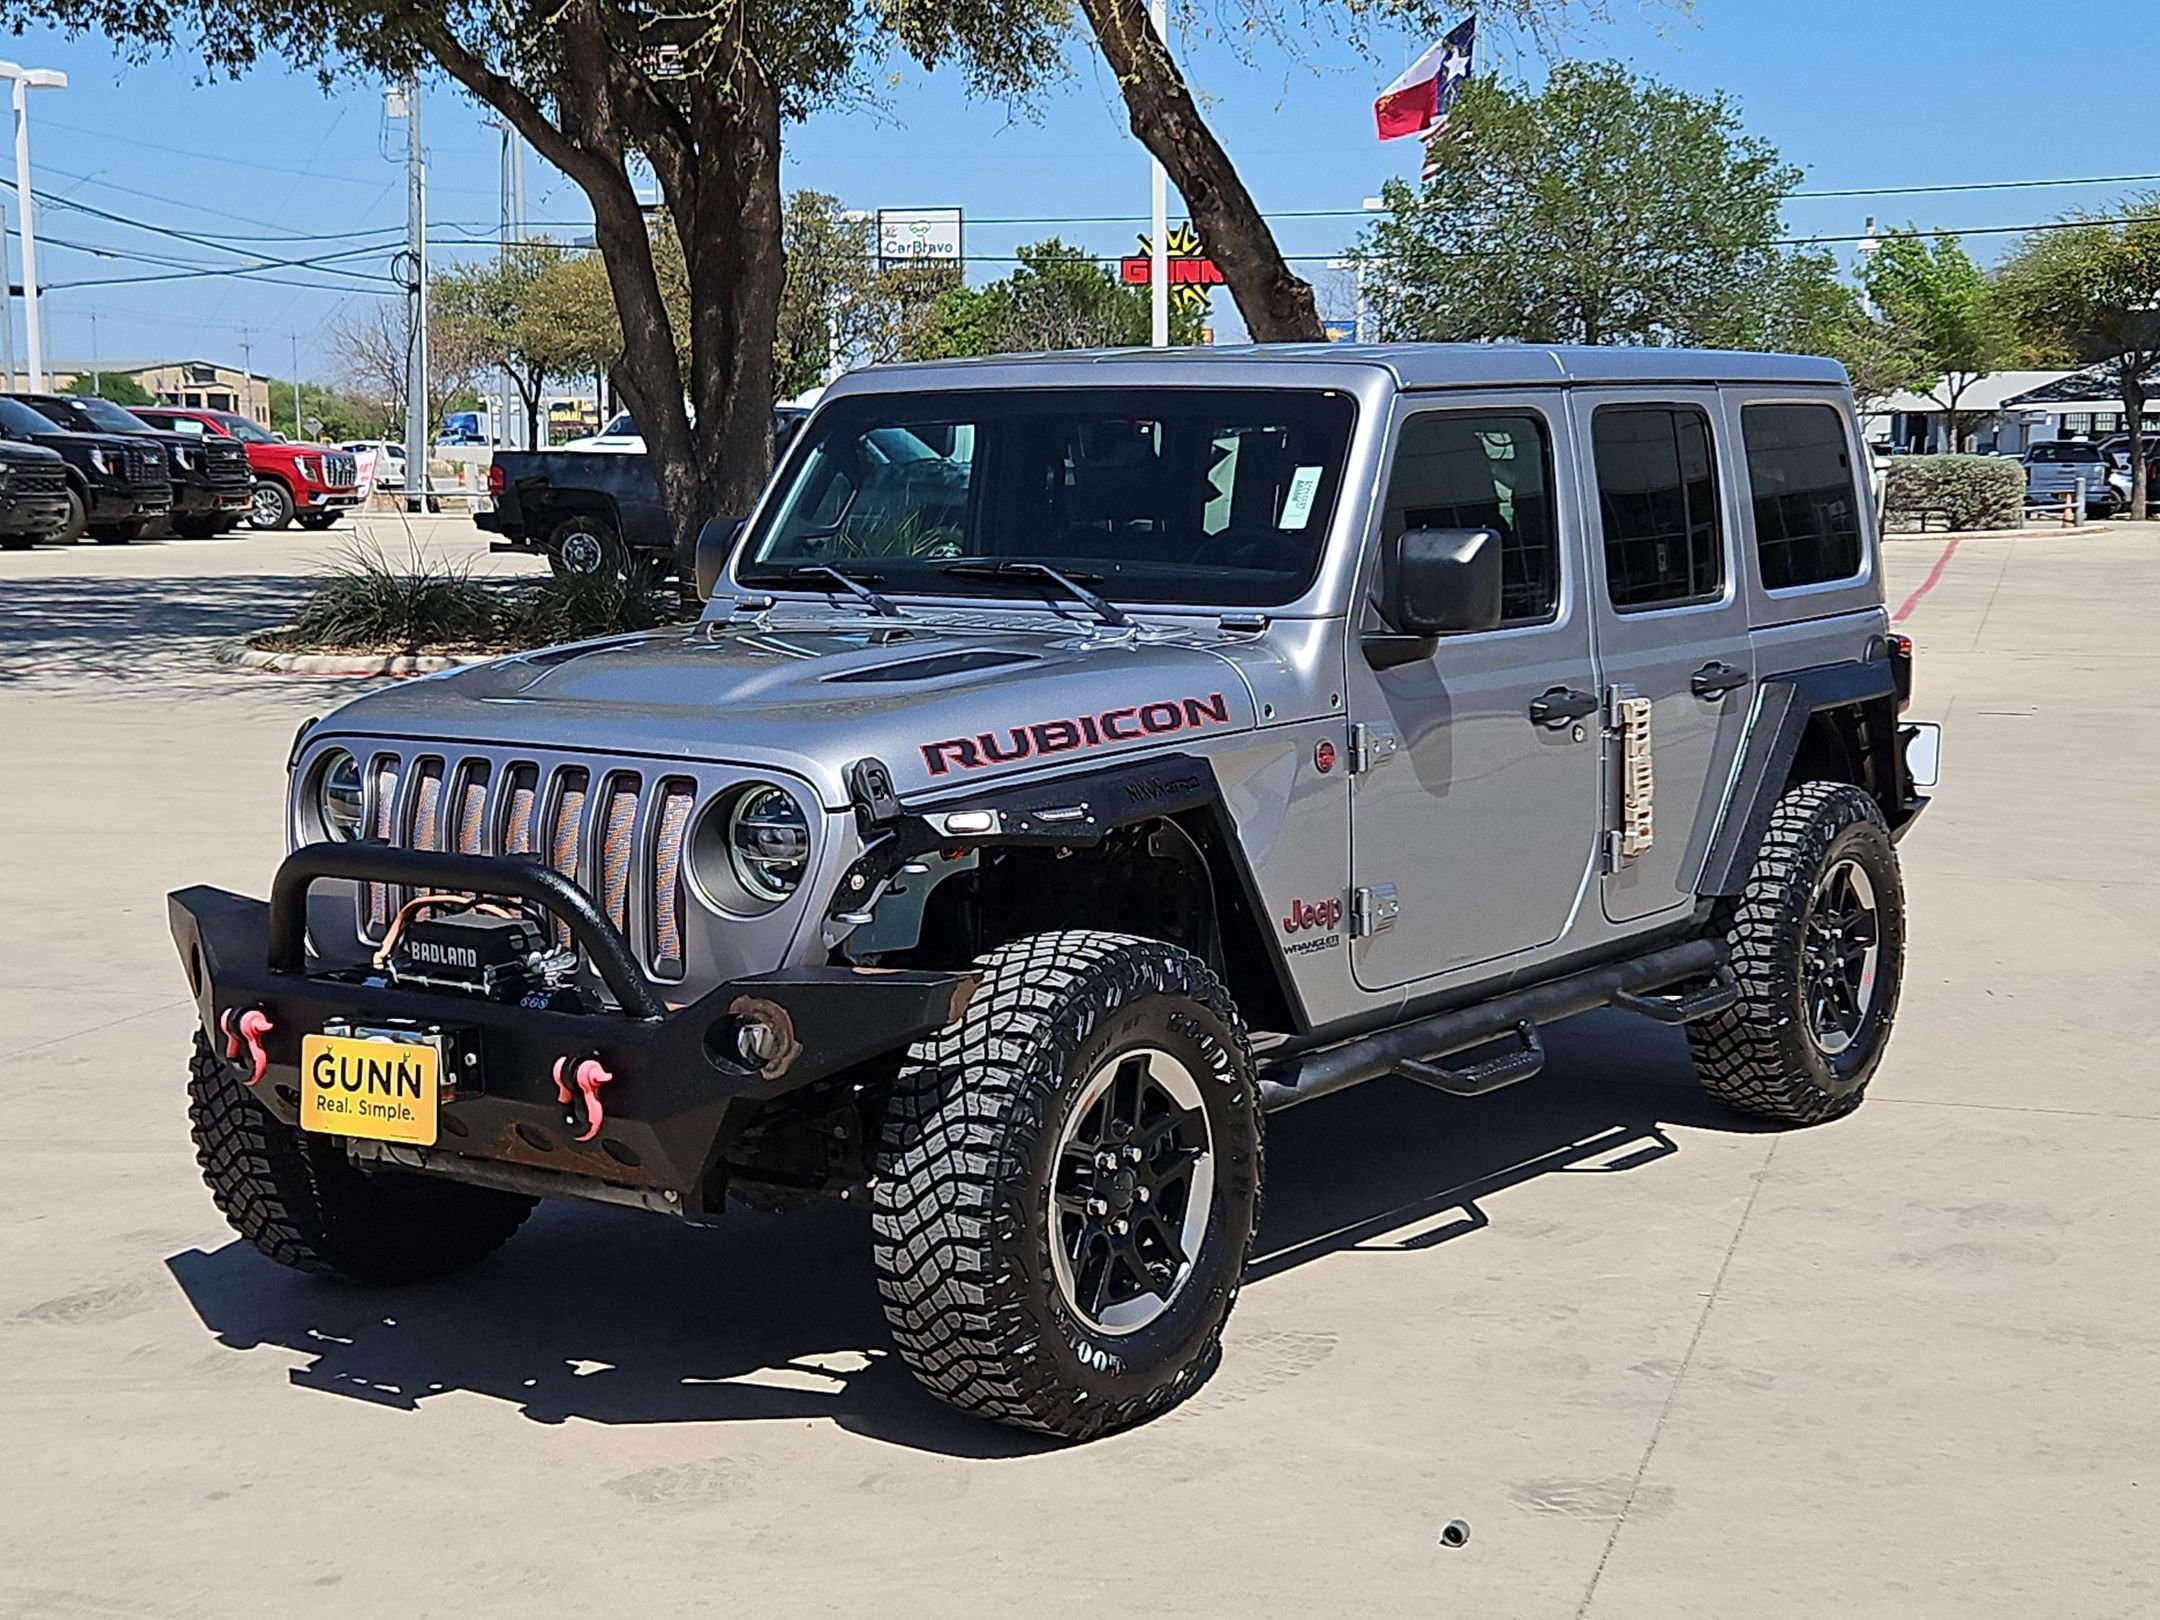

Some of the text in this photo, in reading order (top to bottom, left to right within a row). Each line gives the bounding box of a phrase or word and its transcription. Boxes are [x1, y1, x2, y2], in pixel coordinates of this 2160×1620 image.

[886, 240, 953, 254] CarBravo
[919, 692, 1230, 777] RUBICON
[1283, 896, 1343, 934] Jeep
[411, 941, 477, 968] BADLAND
[312, 1053, 422, 1099] GUNN
[316, 1094, 353, 1114] Real.
